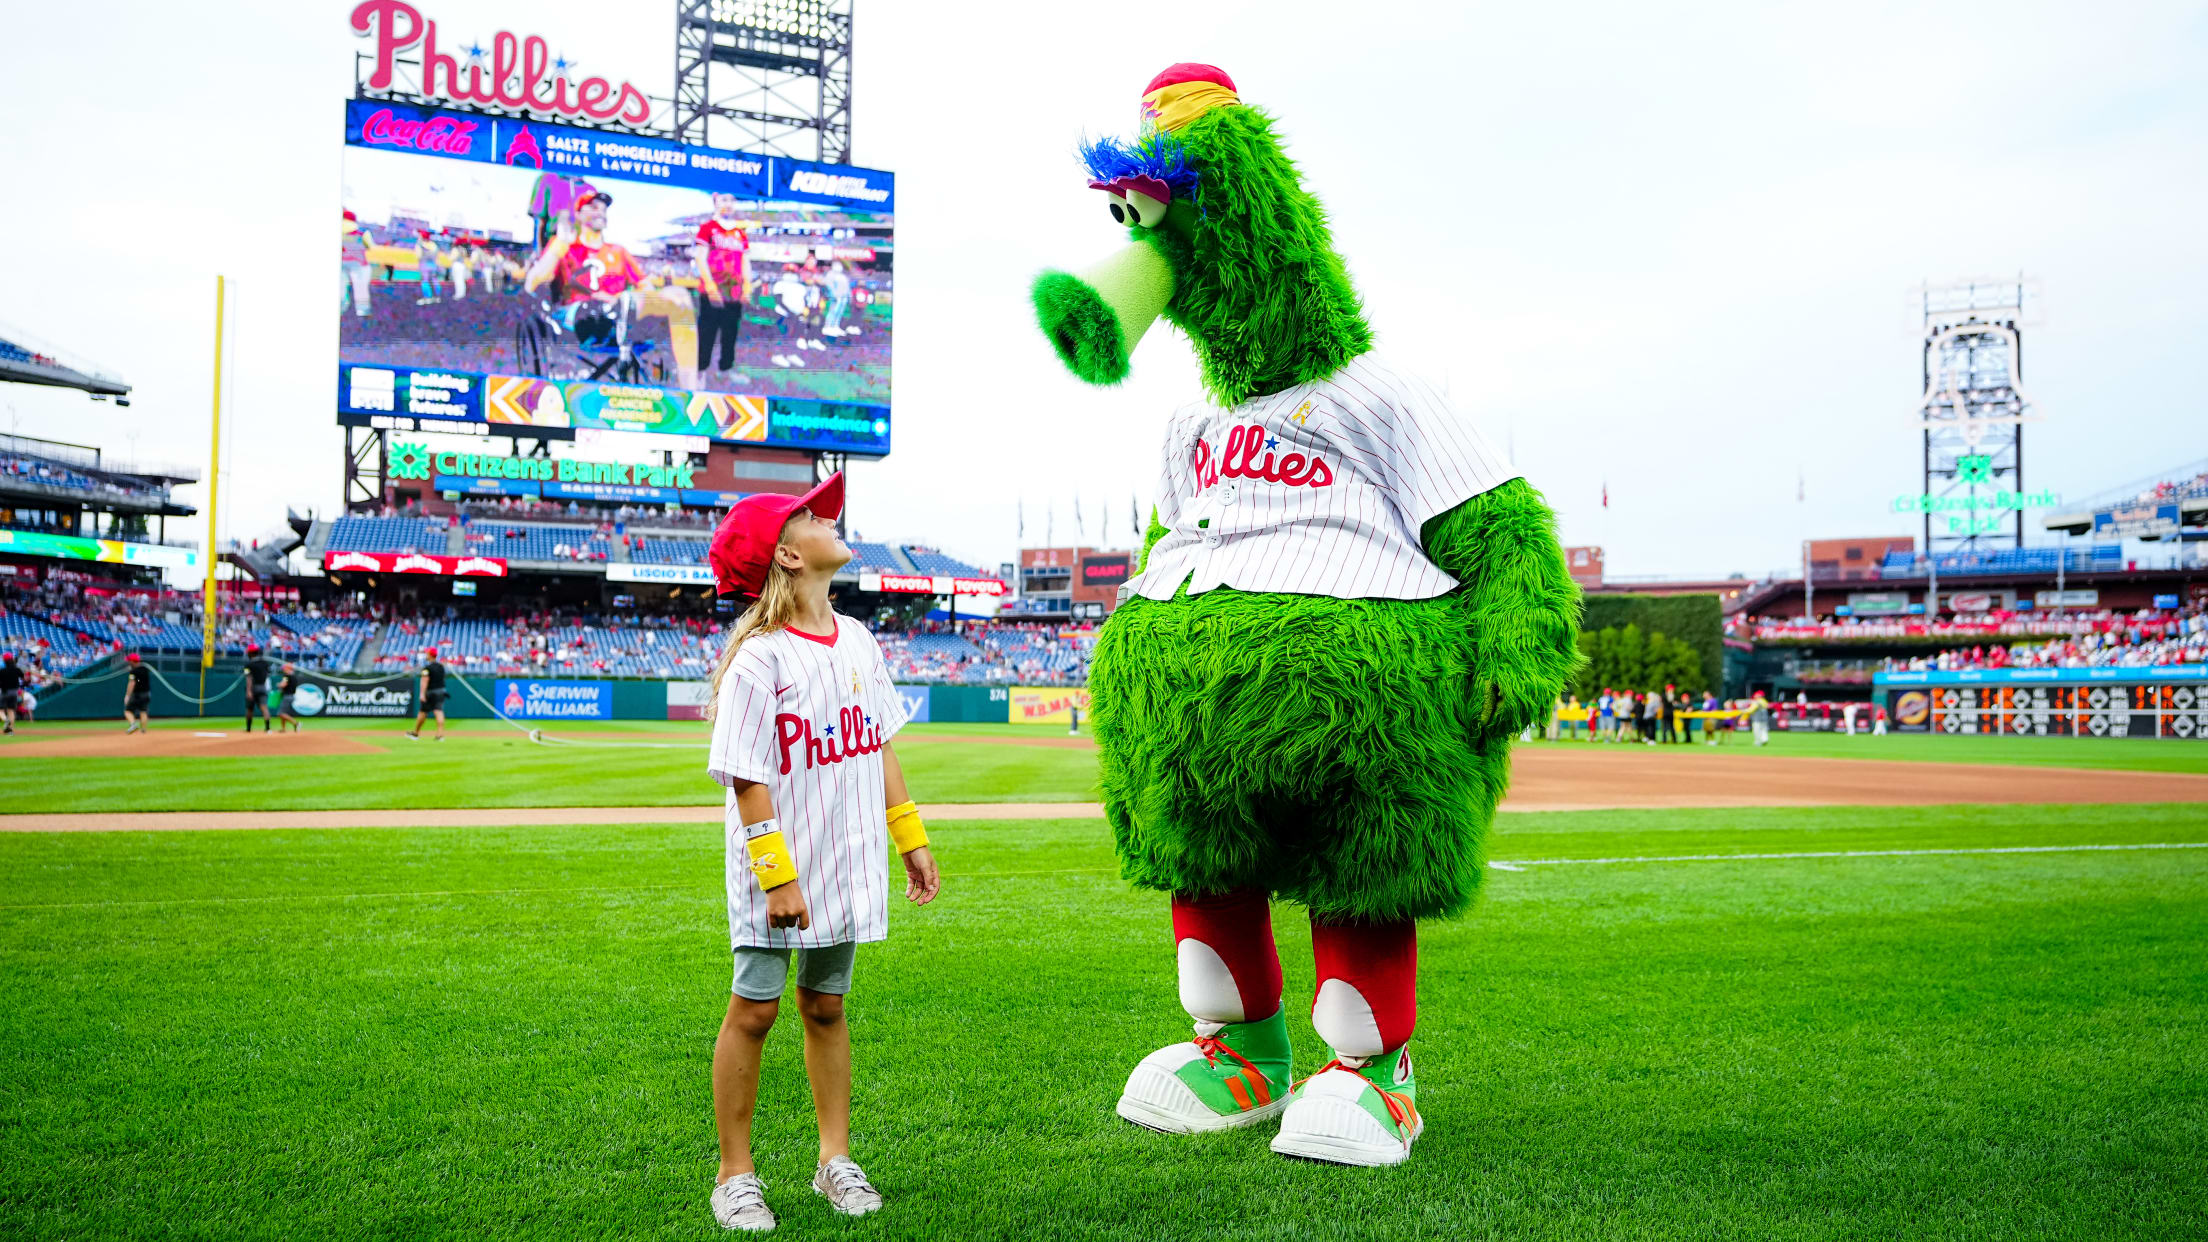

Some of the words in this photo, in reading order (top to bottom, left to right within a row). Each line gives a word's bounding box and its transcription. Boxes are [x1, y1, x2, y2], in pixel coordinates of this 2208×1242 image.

[350, 0, 651, 125] Phillies
[546, 135, 589, 153] SALTZ
[595, 142, 687, 166] MONGELUZZI
[691, 154, 762, 175] BENDESKY
[547, 151, 590, 168] TRIAL
[602, 158, 671, 178] LAWYERS
[410, 372, 469, 393] Building
[435, 451, 554, 482] Citizens
[558, 458, 630, 485] Bank
[633, 462, 694, 489] Park
[633, 567, 687, 579] LISCIO'S
[1086, 565, 1126, 577] GIANT
[882, 577, 931, 591] TOYOTA
[955, 579, 1003, 594] TOYOTA
[326, 686, 411, 706] NovaCare
[528, 684, 599, 700] SHERWIN
